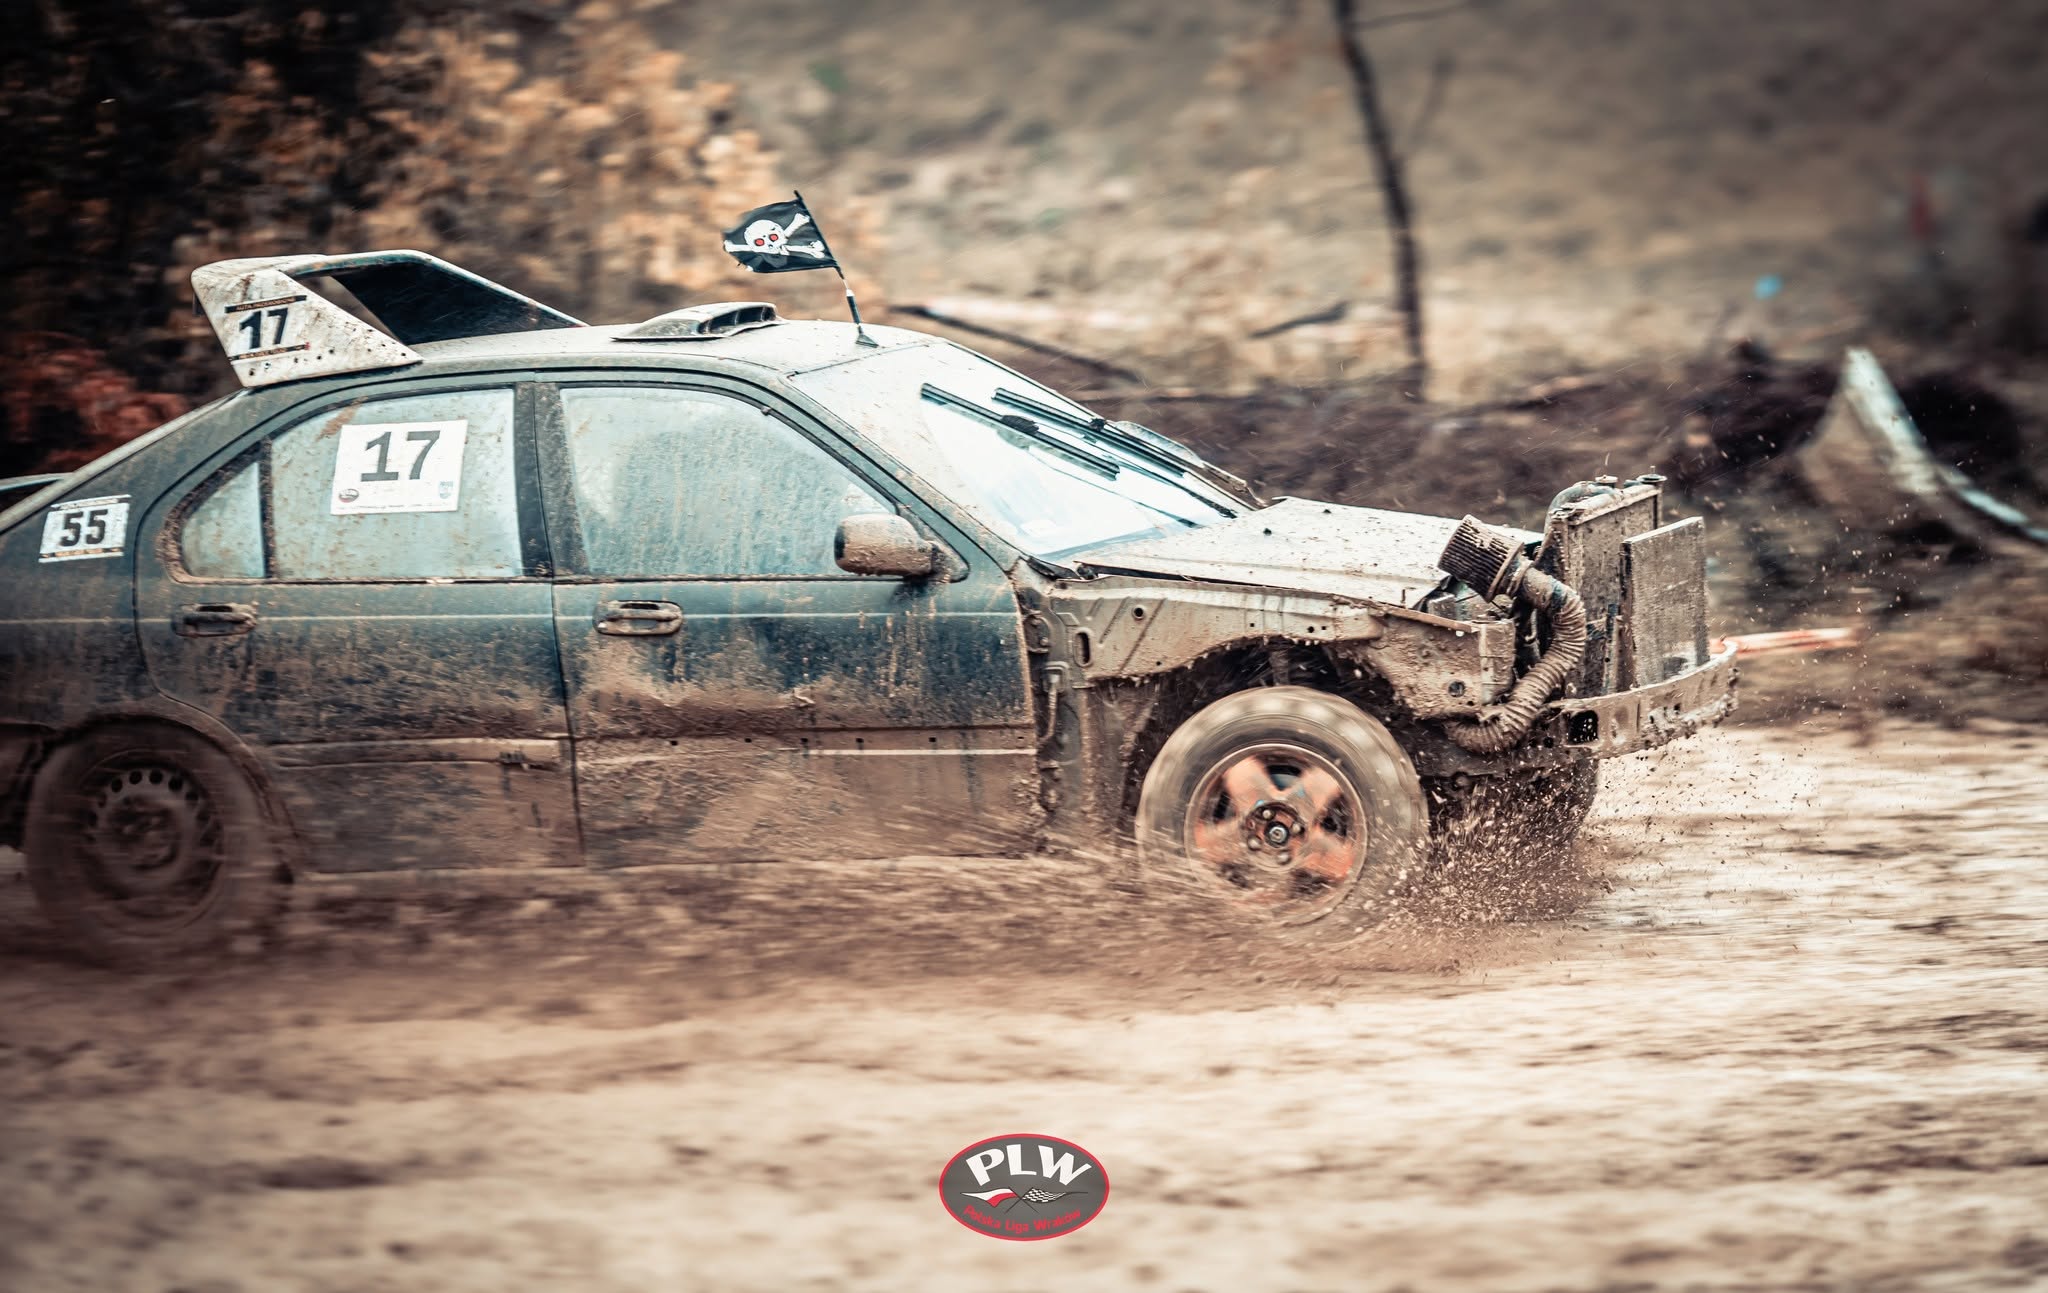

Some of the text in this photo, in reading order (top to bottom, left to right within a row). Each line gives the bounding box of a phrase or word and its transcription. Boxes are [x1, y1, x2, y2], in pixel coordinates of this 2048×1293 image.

[239, 307, 288, 349] 17
[360, 430, 441, 482] 17
[59, 509, 108, 547] 55
